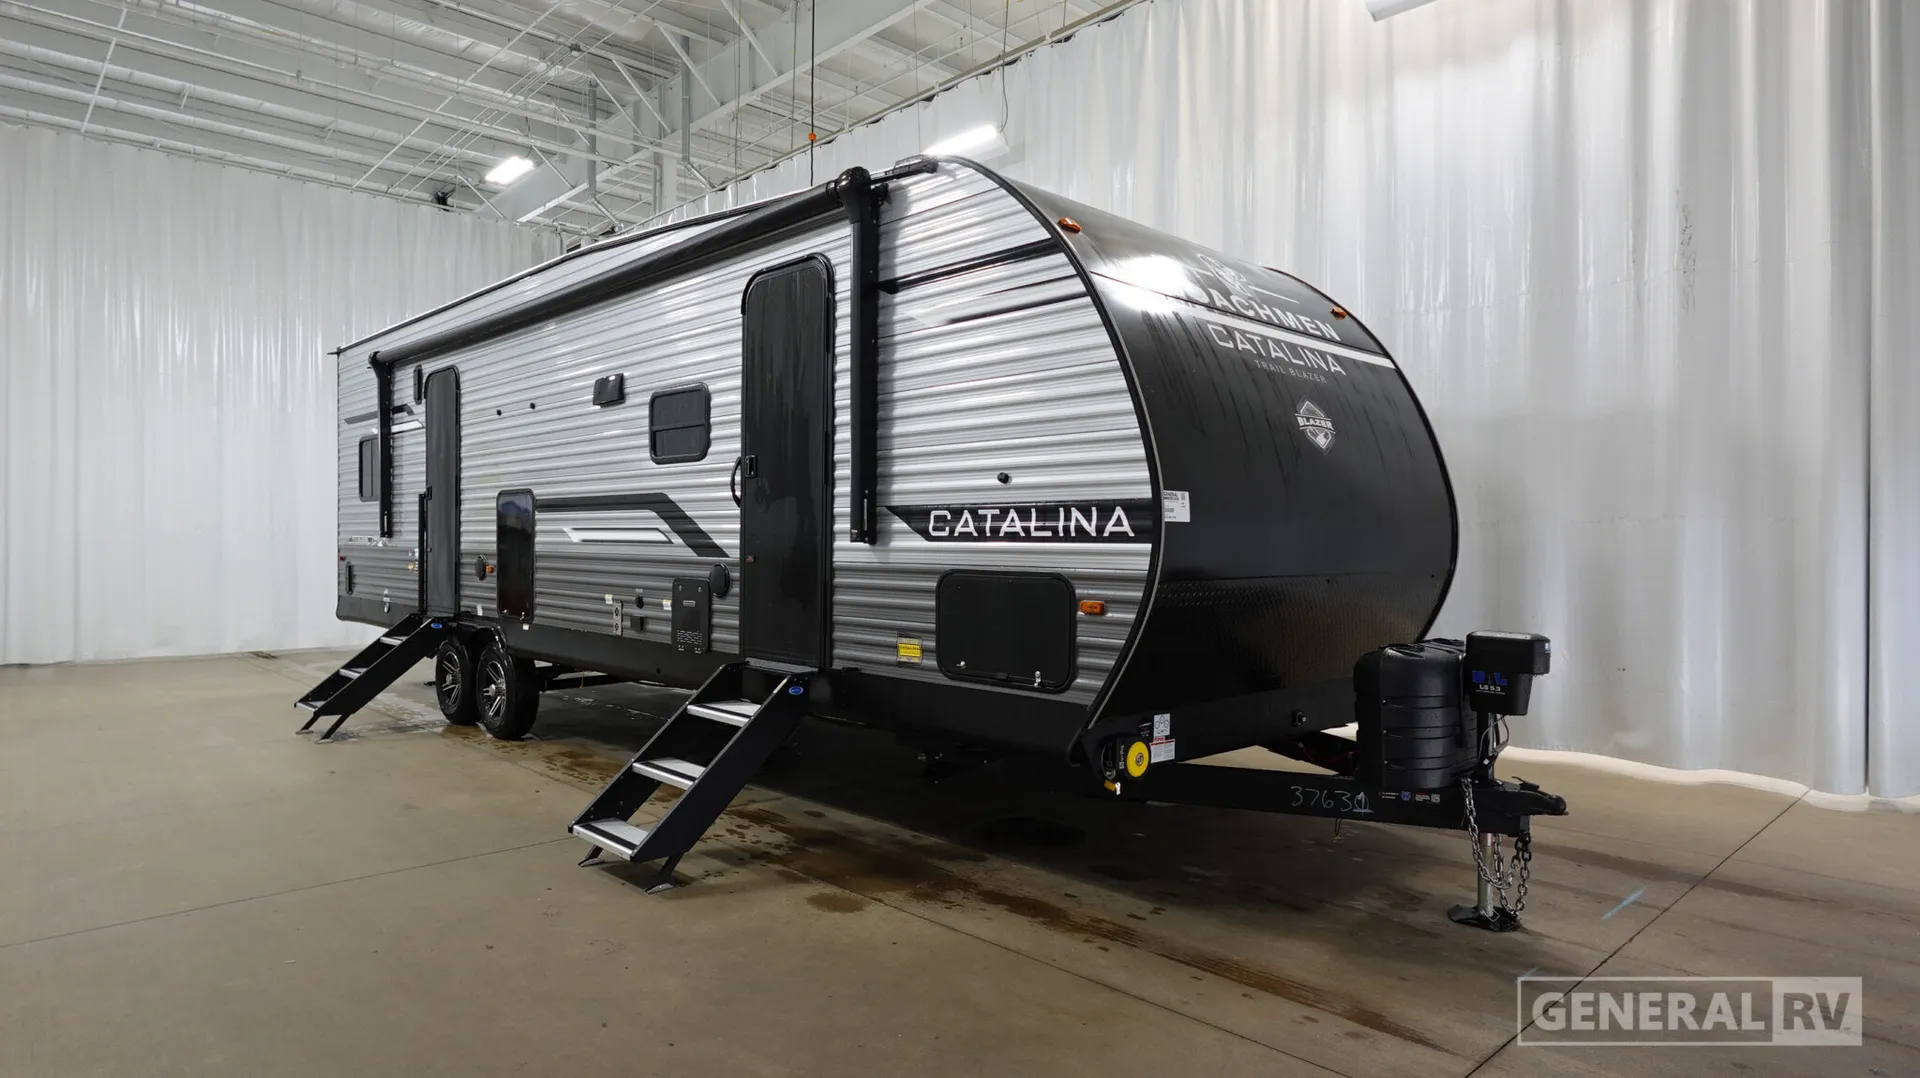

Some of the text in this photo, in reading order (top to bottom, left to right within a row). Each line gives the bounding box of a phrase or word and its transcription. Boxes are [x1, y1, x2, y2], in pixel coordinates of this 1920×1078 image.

[1178, 279, 1341, 342] OACHMEN
[1206, 323, 1347, 376] CATALINA
[1254, 359, 1328, 384] TRAIL BLAZER
[1296, 416, 1335, 431] BLAZER
[928, 506, 1135, 538] CATALINA
